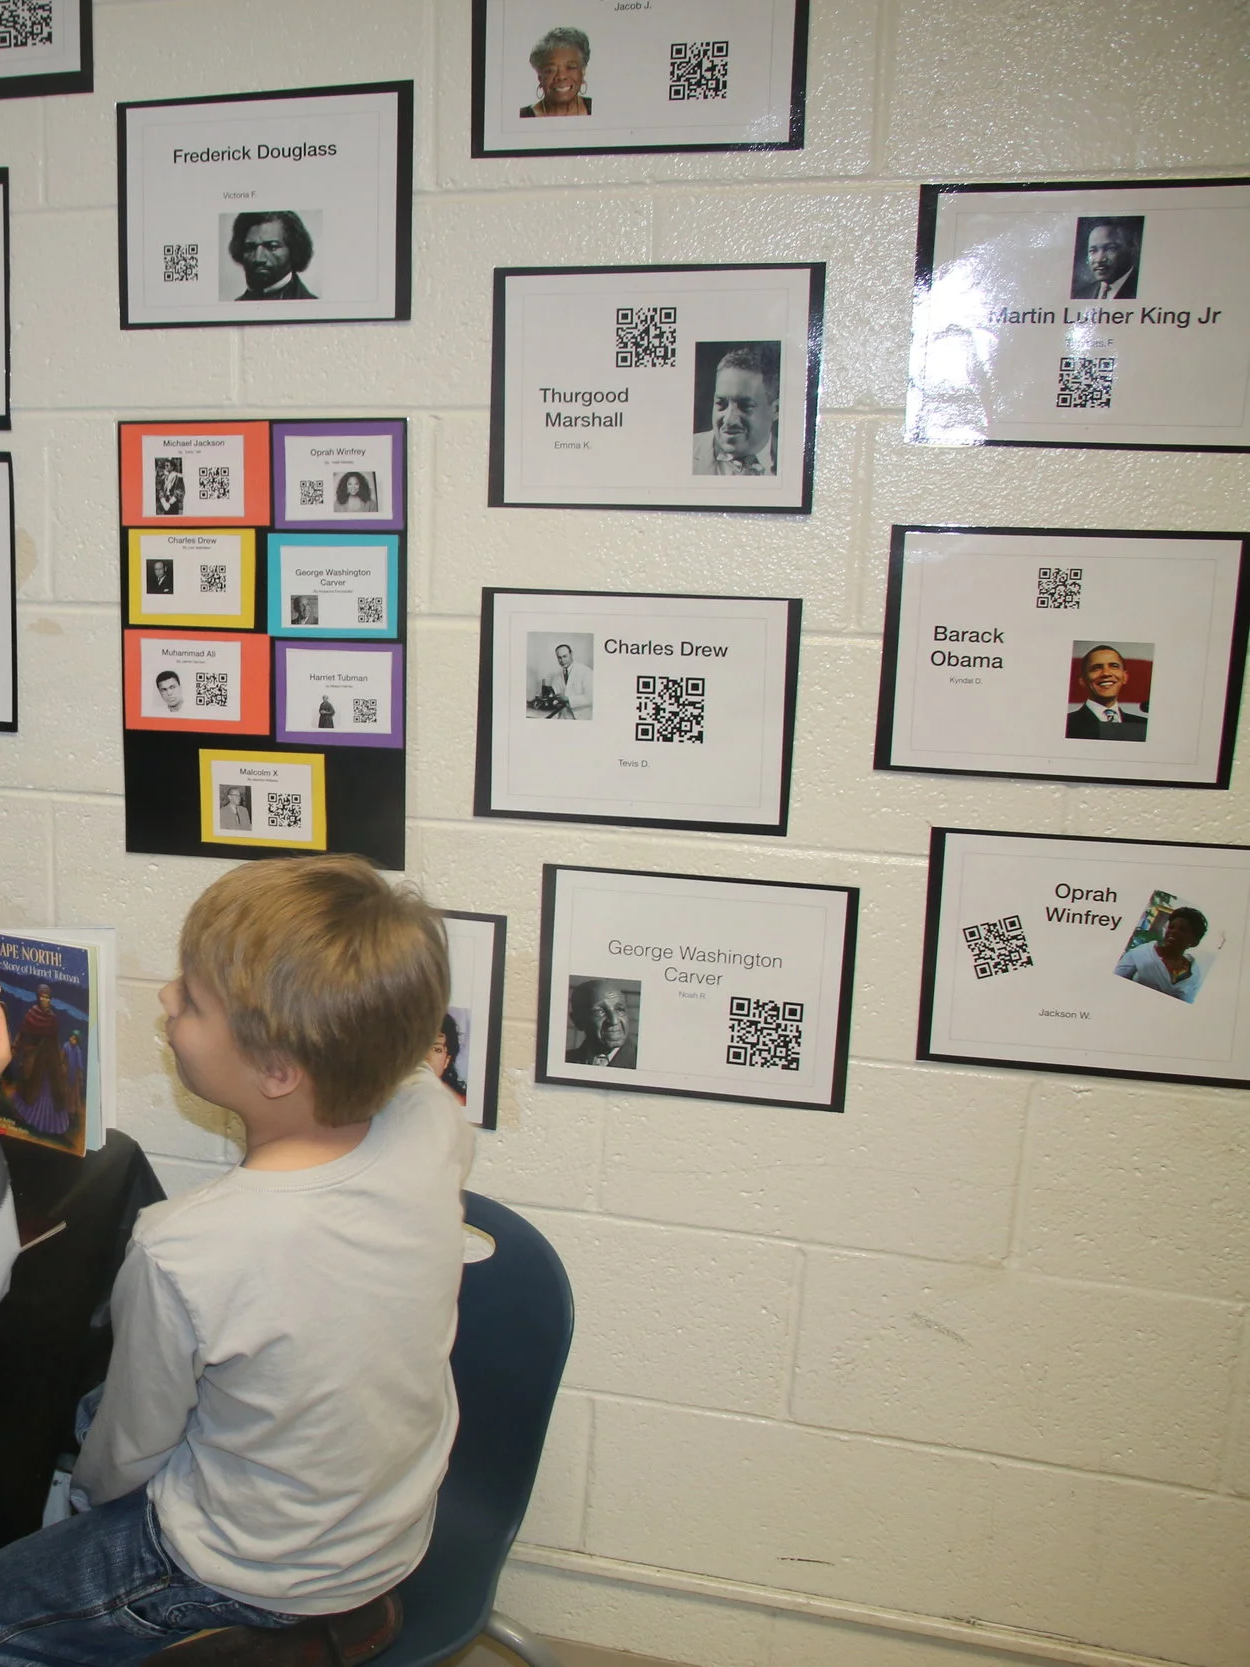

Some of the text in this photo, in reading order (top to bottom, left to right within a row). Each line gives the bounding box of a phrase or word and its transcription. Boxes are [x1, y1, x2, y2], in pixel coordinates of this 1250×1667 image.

[614, 1, 653, 12] Jacob J.
[173, 142, 337, 164] Frederick Douglass
[222, 191, 250, 200] Victoria
[989, 306, 1222, 328] Martin Luther King Jr
[539, 387, 630, 407] Thurgood
[545, 412, 624, 428] Marshall
[163, 439, 225, 447] Michael Jackson
[554, 441, 581, 449] Emma
[310, 447, 366, 457] Oprah Winfrey
[167, 536, 217, 545] Charles Drew
[295, 568, 371, 578] George Washington
[320, 578, 346, 587] Carver
[933, 626, 1005, 643] Barack
[161, 648, 216, 658] Muhammad Ali
[603, 638, 729, 658] Charles Drew
[930, 650, 1004, 669] Obama
[309, 673, 368, 682] Harriet Tubman
[618, 759, 639, 768] Tevis
[239, 768, 279, 777] Malcolm X
[1054, 883, 1118, 903] Oprah
[1045, 906, 1122, 931] Winfrey
[21, 946, 62, 967] NORTH!
[608, 939, 783, 970] George Washington
[3, 960, 21, 975] Story
[20, 964, 29, 974] of
[29, 965, 52, 978] Harriet
[52, 969, 80, 984] Tubman
[664, 966, 724, 986] Carver
[678, 990, 698, 999] Noah
[1038, 1008, 1091, 1020] Jackson W.
